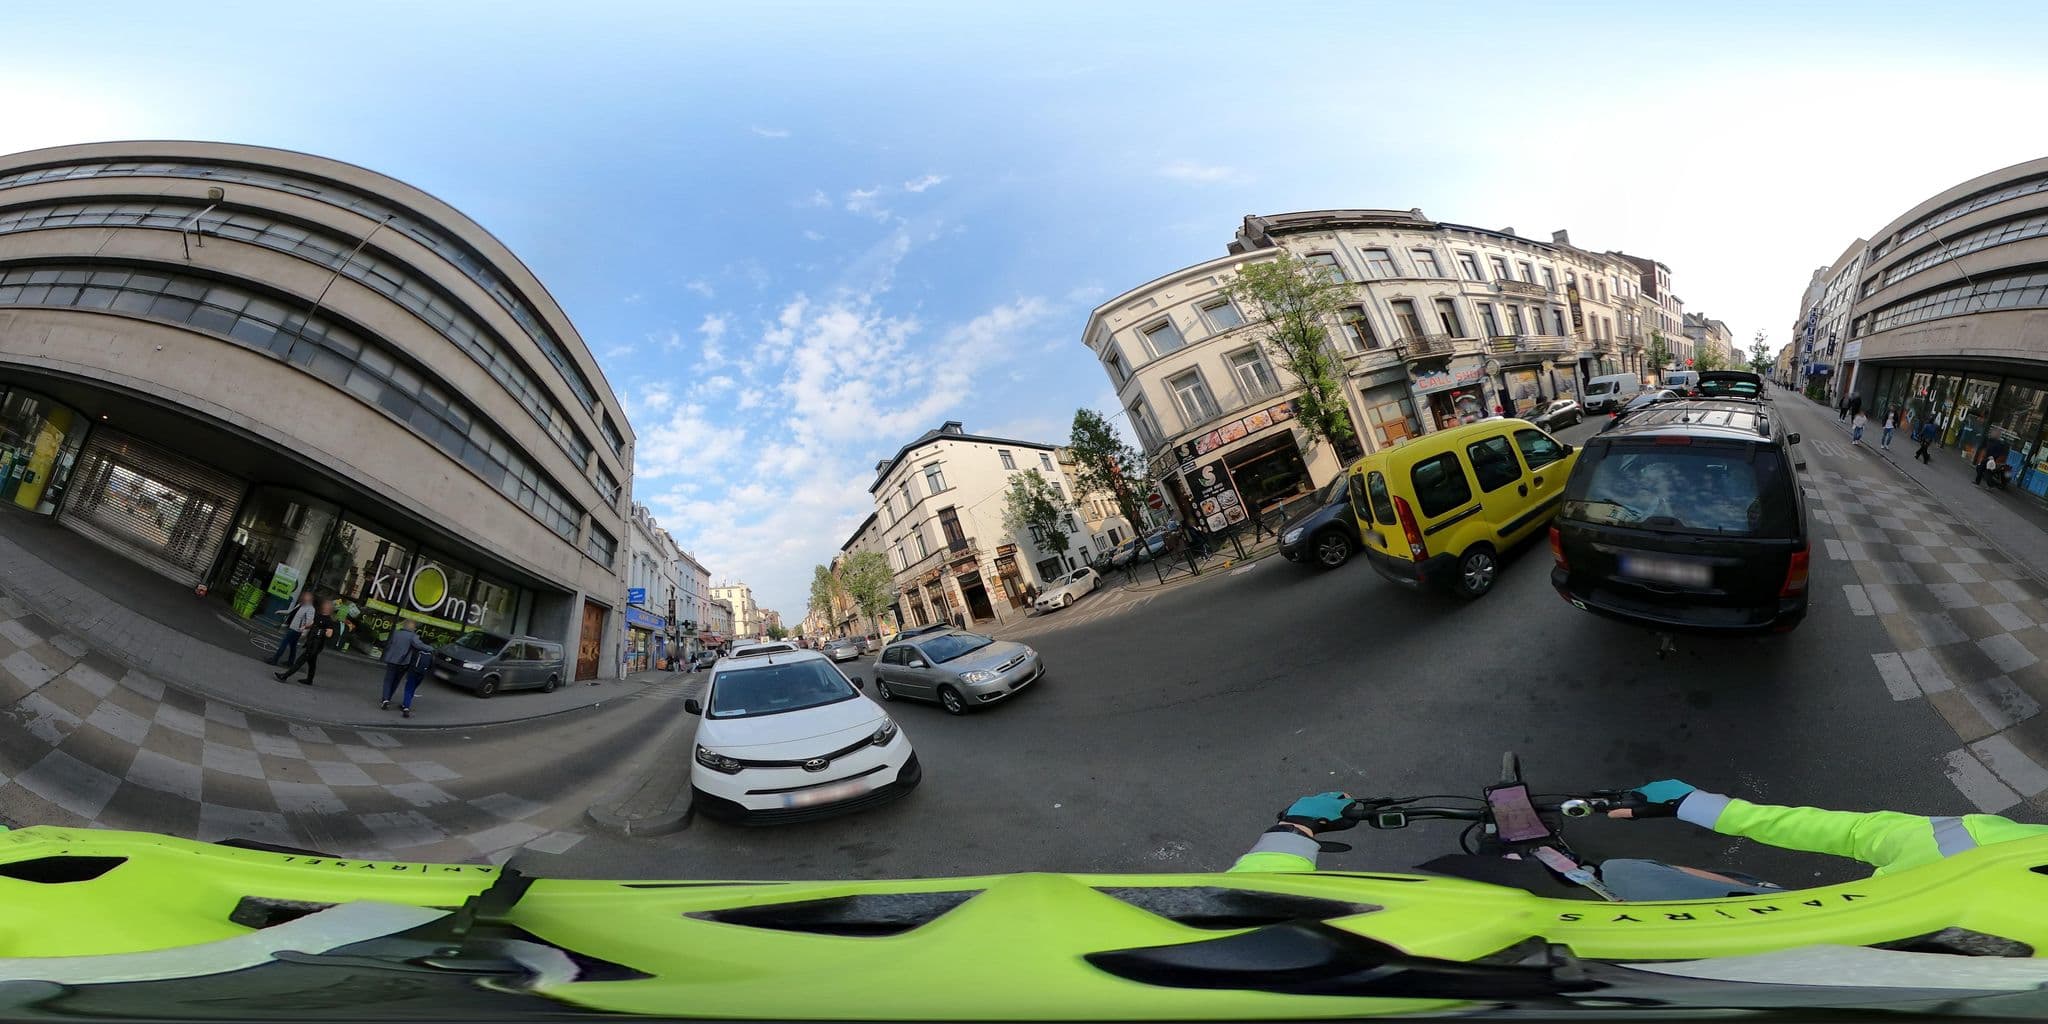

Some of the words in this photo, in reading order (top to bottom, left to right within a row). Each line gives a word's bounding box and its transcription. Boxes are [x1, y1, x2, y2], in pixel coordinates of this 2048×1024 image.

[1806, 307, 1818, 353] HOTEL
[1419, 373, 1452, 389] CALL
[1810, 439, 1864, 461] BUS
